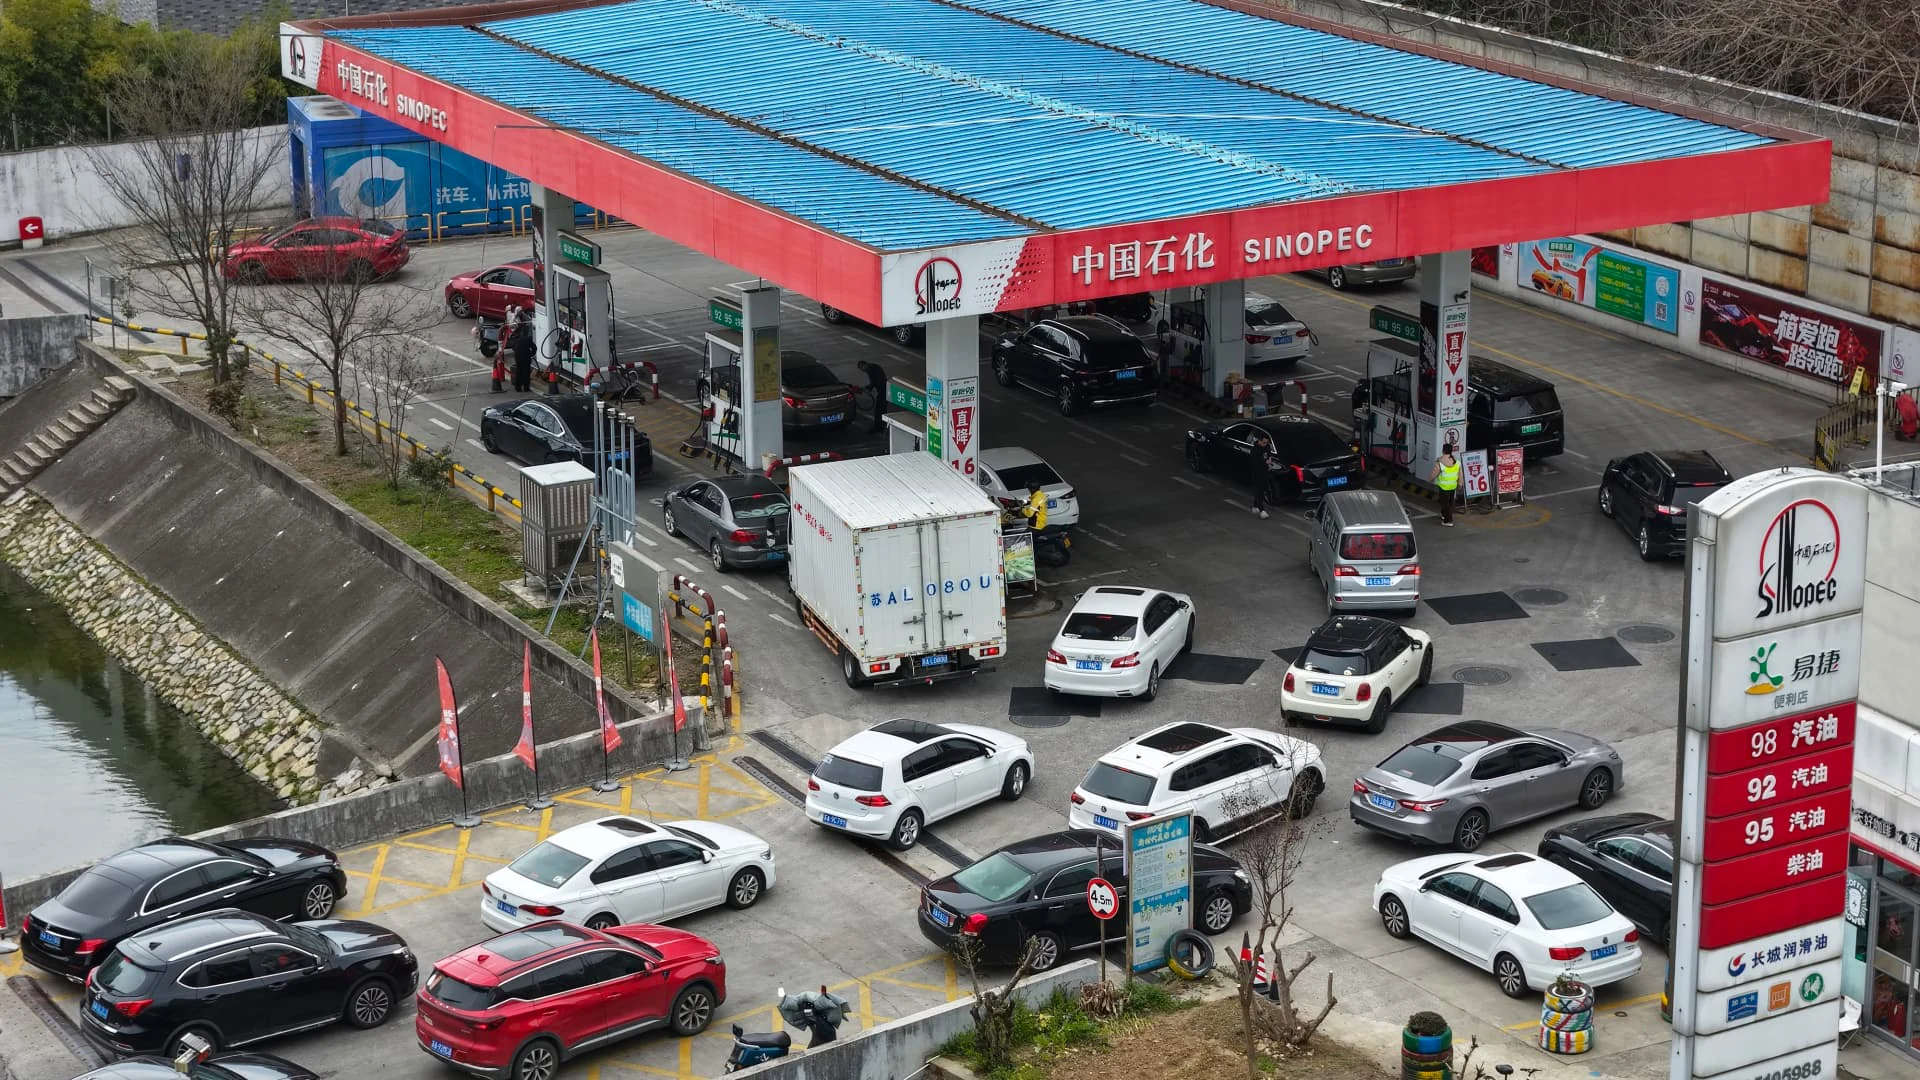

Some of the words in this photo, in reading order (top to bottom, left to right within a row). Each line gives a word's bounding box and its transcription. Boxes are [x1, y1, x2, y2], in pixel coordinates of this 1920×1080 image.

[337, 59, 388, 108] 中国石化
[396, 94, 448, 132] SINOPEC
[573, 247, 581, 258] 92
[581, 249, 590, 261] 92
[1072, 232, 1215, 285] 中国石化
[1244, 224, 1373, 263] SINOPEC
[915, 262, 961, 315] SINOPEC
[714, 309, 722, 321] 92
[724, 312, 733, 325] 95
[1391, 322, 1401, 333] 95
[1405, 325, 1415, 337] 92
[1758, 310, 1840, 356] 一箱爱跑
[896, 391, 906, 404] 95
[1444, 379, 1465, 397] 1.6
[956, 410, 969, 445] 直降
[1468, 475, 1488, 492] 1.6
[1755, 505, 1837, 619] SINOPEC
[1791, 649, 1841, 682] 易捷
[1774, 690, 1808, 710] 便利店
[1751, 729, 1777, 758] 98
[1791, 713, 1839, 748] 汽油
[1747, 775, 1777, 802] 92
[1791, 762, 1828, 789] 汽油
[1744, 816, 1774, 845] 95
[1788, 806, 1826, 832] 汽油
[1786, 849, 1824, 876] 柴油
[1090, 889, 1113, 907] 4.5m
[1751, 933, 1828, 969] 长城润滑油
